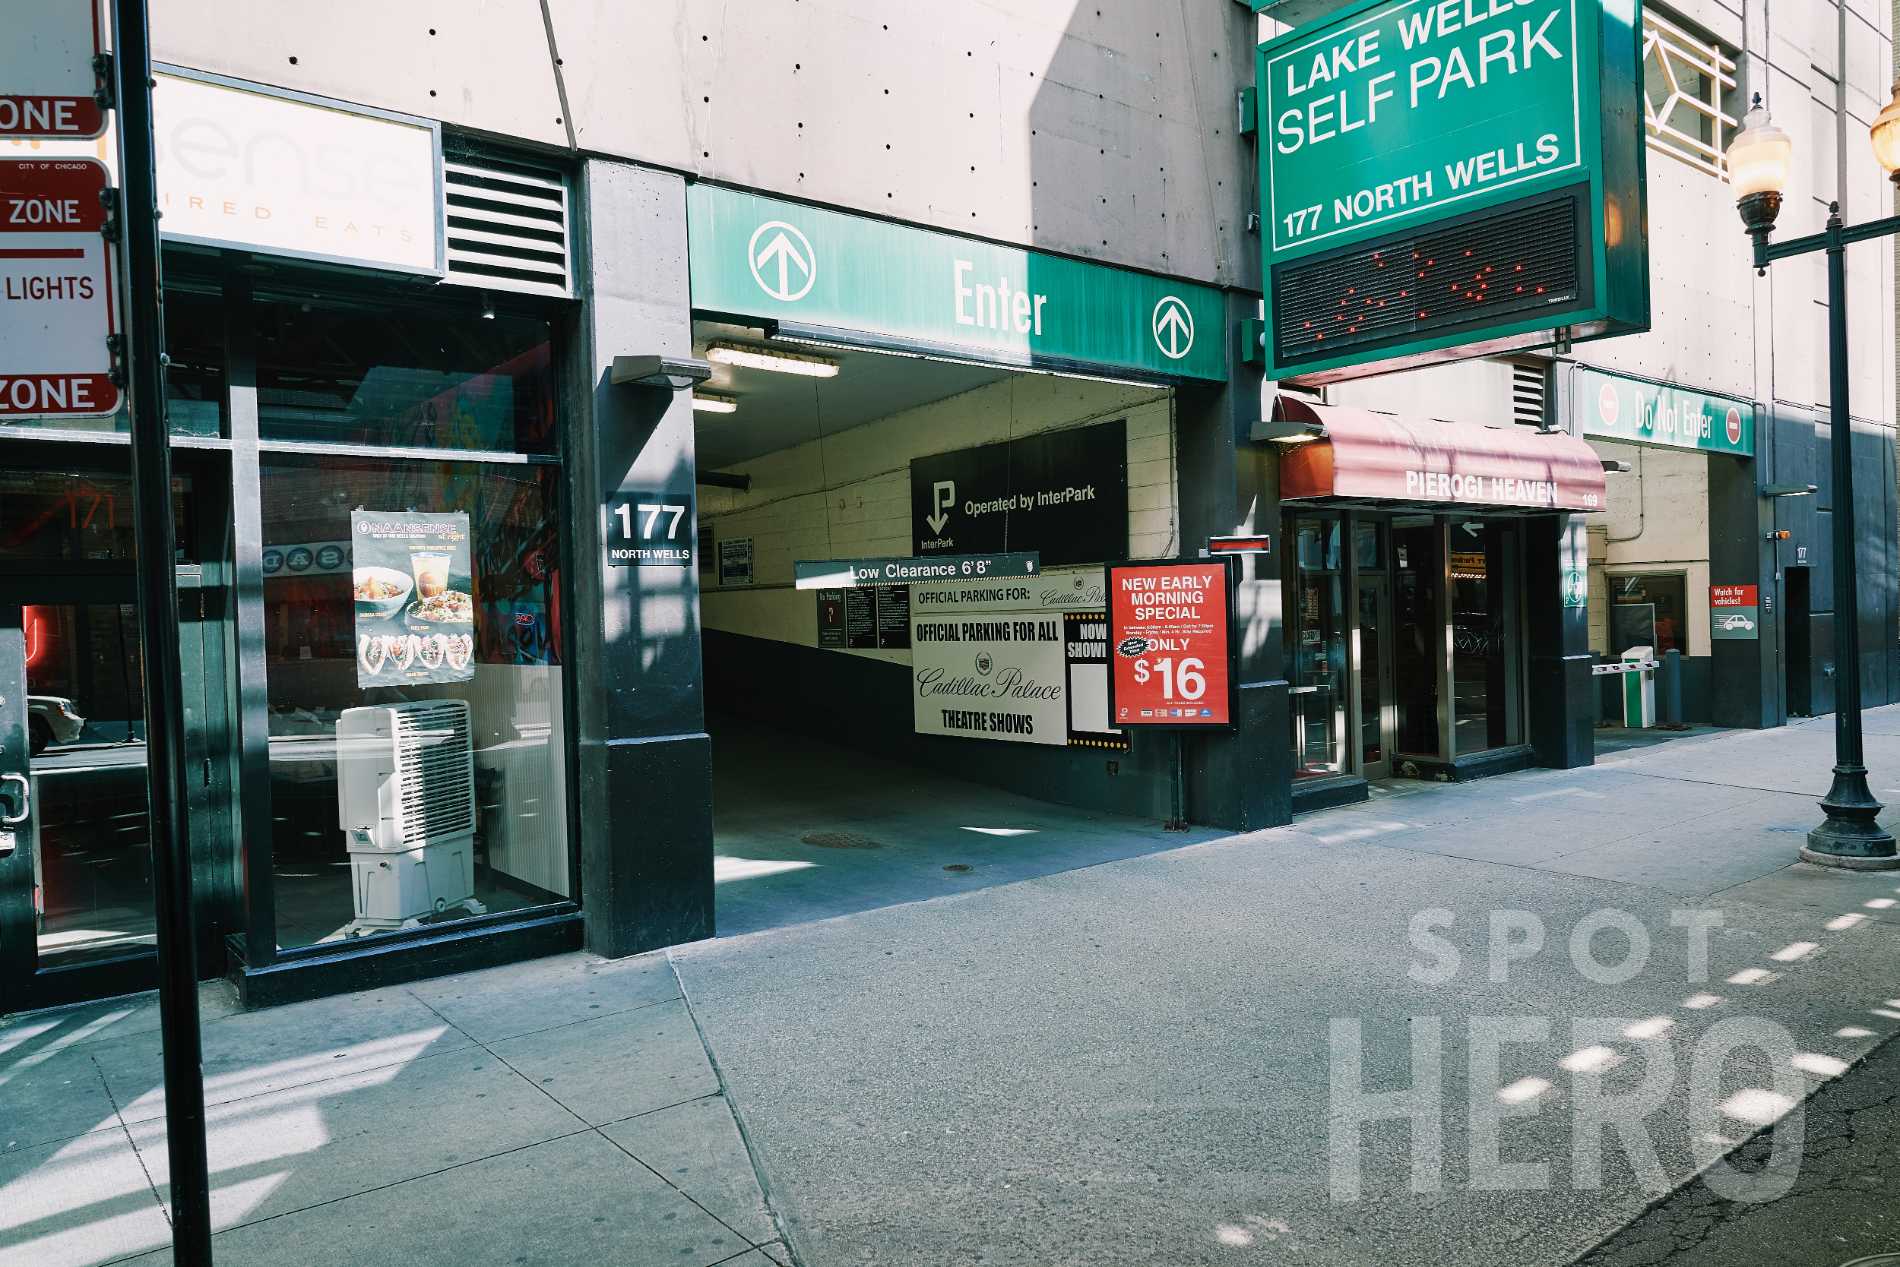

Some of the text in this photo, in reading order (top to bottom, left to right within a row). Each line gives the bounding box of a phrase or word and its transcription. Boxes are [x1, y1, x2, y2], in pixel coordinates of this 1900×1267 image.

[1286, 0, 1536, 97] LAKE WELL
[1276, 9, 1564, 155] SELF PARK
[1283, 133, 1560, 238] 177 NORTH WELLS
[9, 199, 81, 224] ZONE
[313, 216, 416, 243] EATS
[6, 276, 94, 300] LIGHTS
[953, 258, 1048, 337] Enter
[1635, 391, 1713, 439] Do Not Enter
[1405, 470, 1558, 504] PIEROGI HEAVEN
[964, 485, 1096, 518] Operated by InterPark
[1583, 494, 1598, 507] 169
[614, 503, 685, 540] 177
[611, 549, 689, 559] NORTH WELLS
[921, 537, 954, 550] InterPark
[850, 565, 879, 580] Low
[885, 561, 957, 578] Clearance
[1122, 575, 1212, 591] NEW EARLY
[1714, 587, 1744, 597] Watch for
[918, 587, 1031, 604] OFFICIAL PARKING FOR:
[1040, 588, 1084, 607] Cadillac
[1131, 591, 1204, 606] MORNING
[1714, 596, 1742, 606] vehicles!
[1135, 607, 1201, 621] SPECIAL
[916, 620, 1059, 643] OFFICIAL PARKING FOR ALL
[1079, 623, 1107, 640] NOW
[1148, 638, 1190, 652] ONLY
[916, 666, 1062, 701] Cadillac Palace
[1134, 657, 1207, 700] $16
[941, 709, 1034, 735] THEATRE SHOWS
